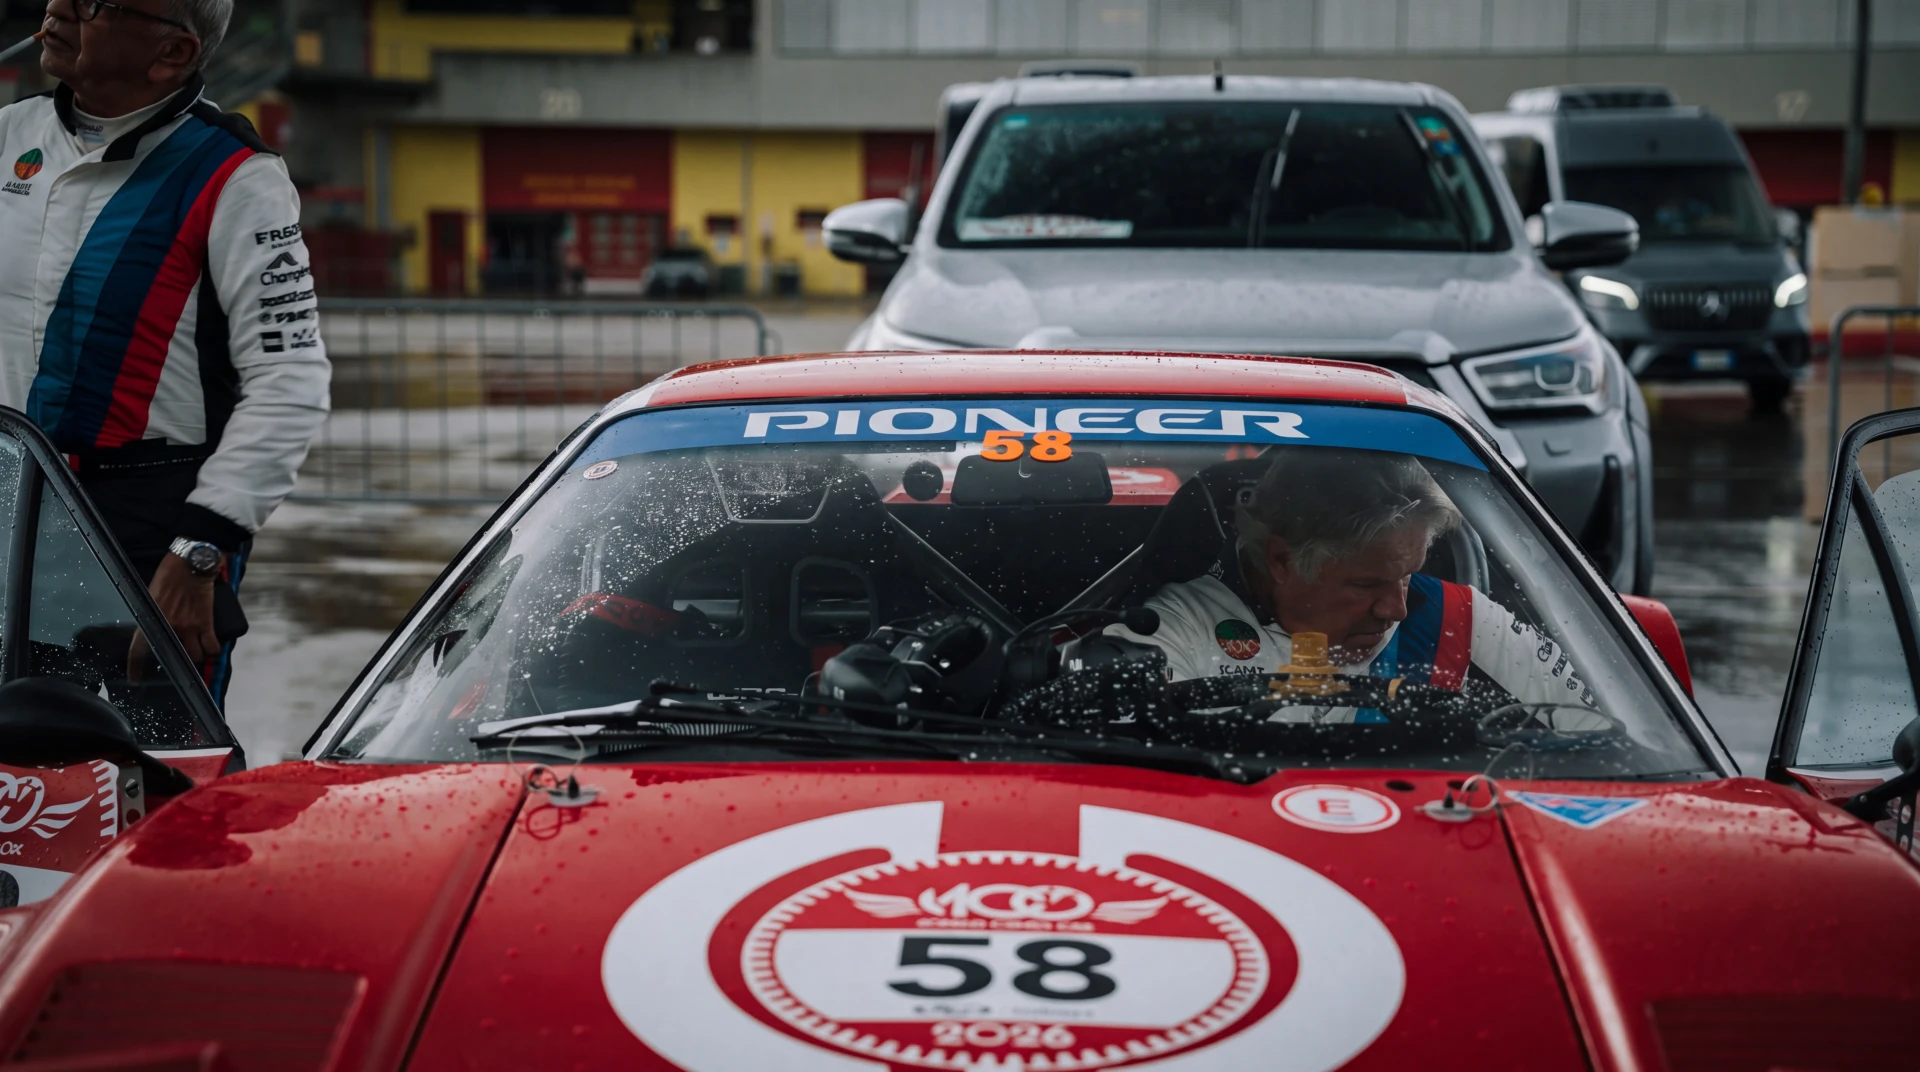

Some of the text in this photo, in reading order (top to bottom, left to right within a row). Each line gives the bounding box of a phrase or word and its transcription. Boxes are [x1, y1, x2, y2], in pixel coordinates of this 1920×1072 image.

[743, 407, 1310, 438] PIONEER
[980, 430, 1073, 462] 58
[888, 936, 1117, 1001] 58
[931, 1022, 1077, 1048] 2026
